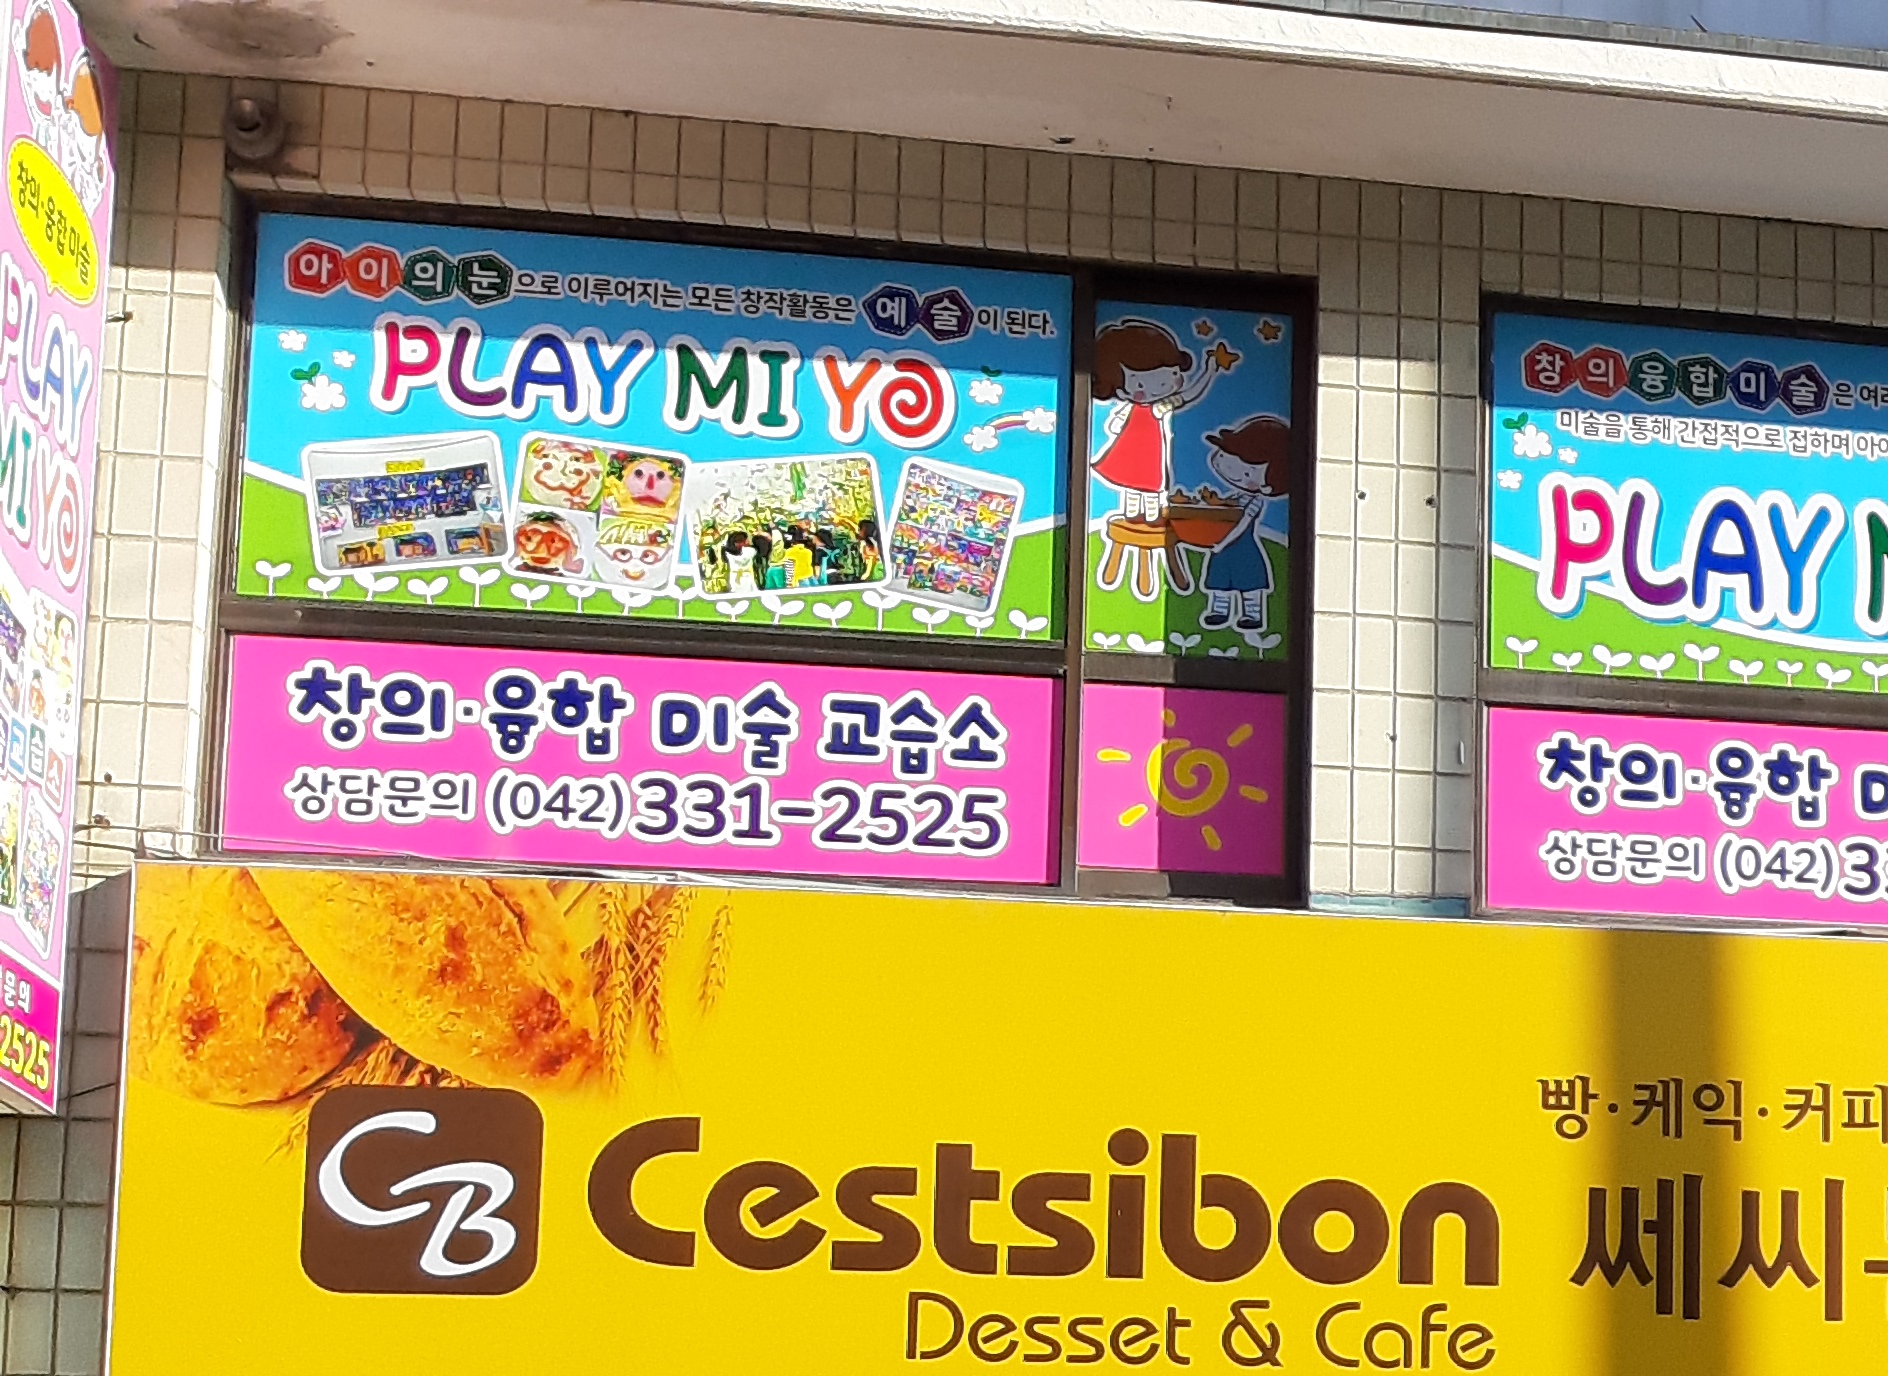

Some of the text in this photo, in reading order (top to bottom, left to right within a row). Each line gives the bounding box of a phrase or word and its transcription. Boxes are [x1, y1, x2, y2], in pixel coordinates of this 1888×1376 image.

[299, 252, 443, 290] 아이의
[468, 264, 562, 298] 눈으로
[568, 276, 682, 308] 이루어지는
[689, 285, 734, 311] 모든
[741, 290, 856, 323] 창작활동은
[1004, 310, 1055, 336] 된다.
[382, 321, 945, 438] PLAY MI YO
[1560, 410, 1624, 436] 미술을
[1631, 417, 1671, 440] 통해
[1678, 421, 1783, 448] 간접적으로
[1789, 431, 1849, 456] 접하며
[1551, 484, 1831, 614] PLAY
[295, 666, 1000, 774] 창의·융합 미술 교습소
[291, 773, 469, 817] 상담문의
[1544, 738, 1832, 821] 창의·융합
[1545, 835, 1699, 877] 상담문의
[0, 965, 30, 1014] 문의
[317, 1110, 516, 1278] CB
[587, 1117, 1501, 1287] Cestsibon
[904, 1292, 1497, 1371] Desset & Cafe
